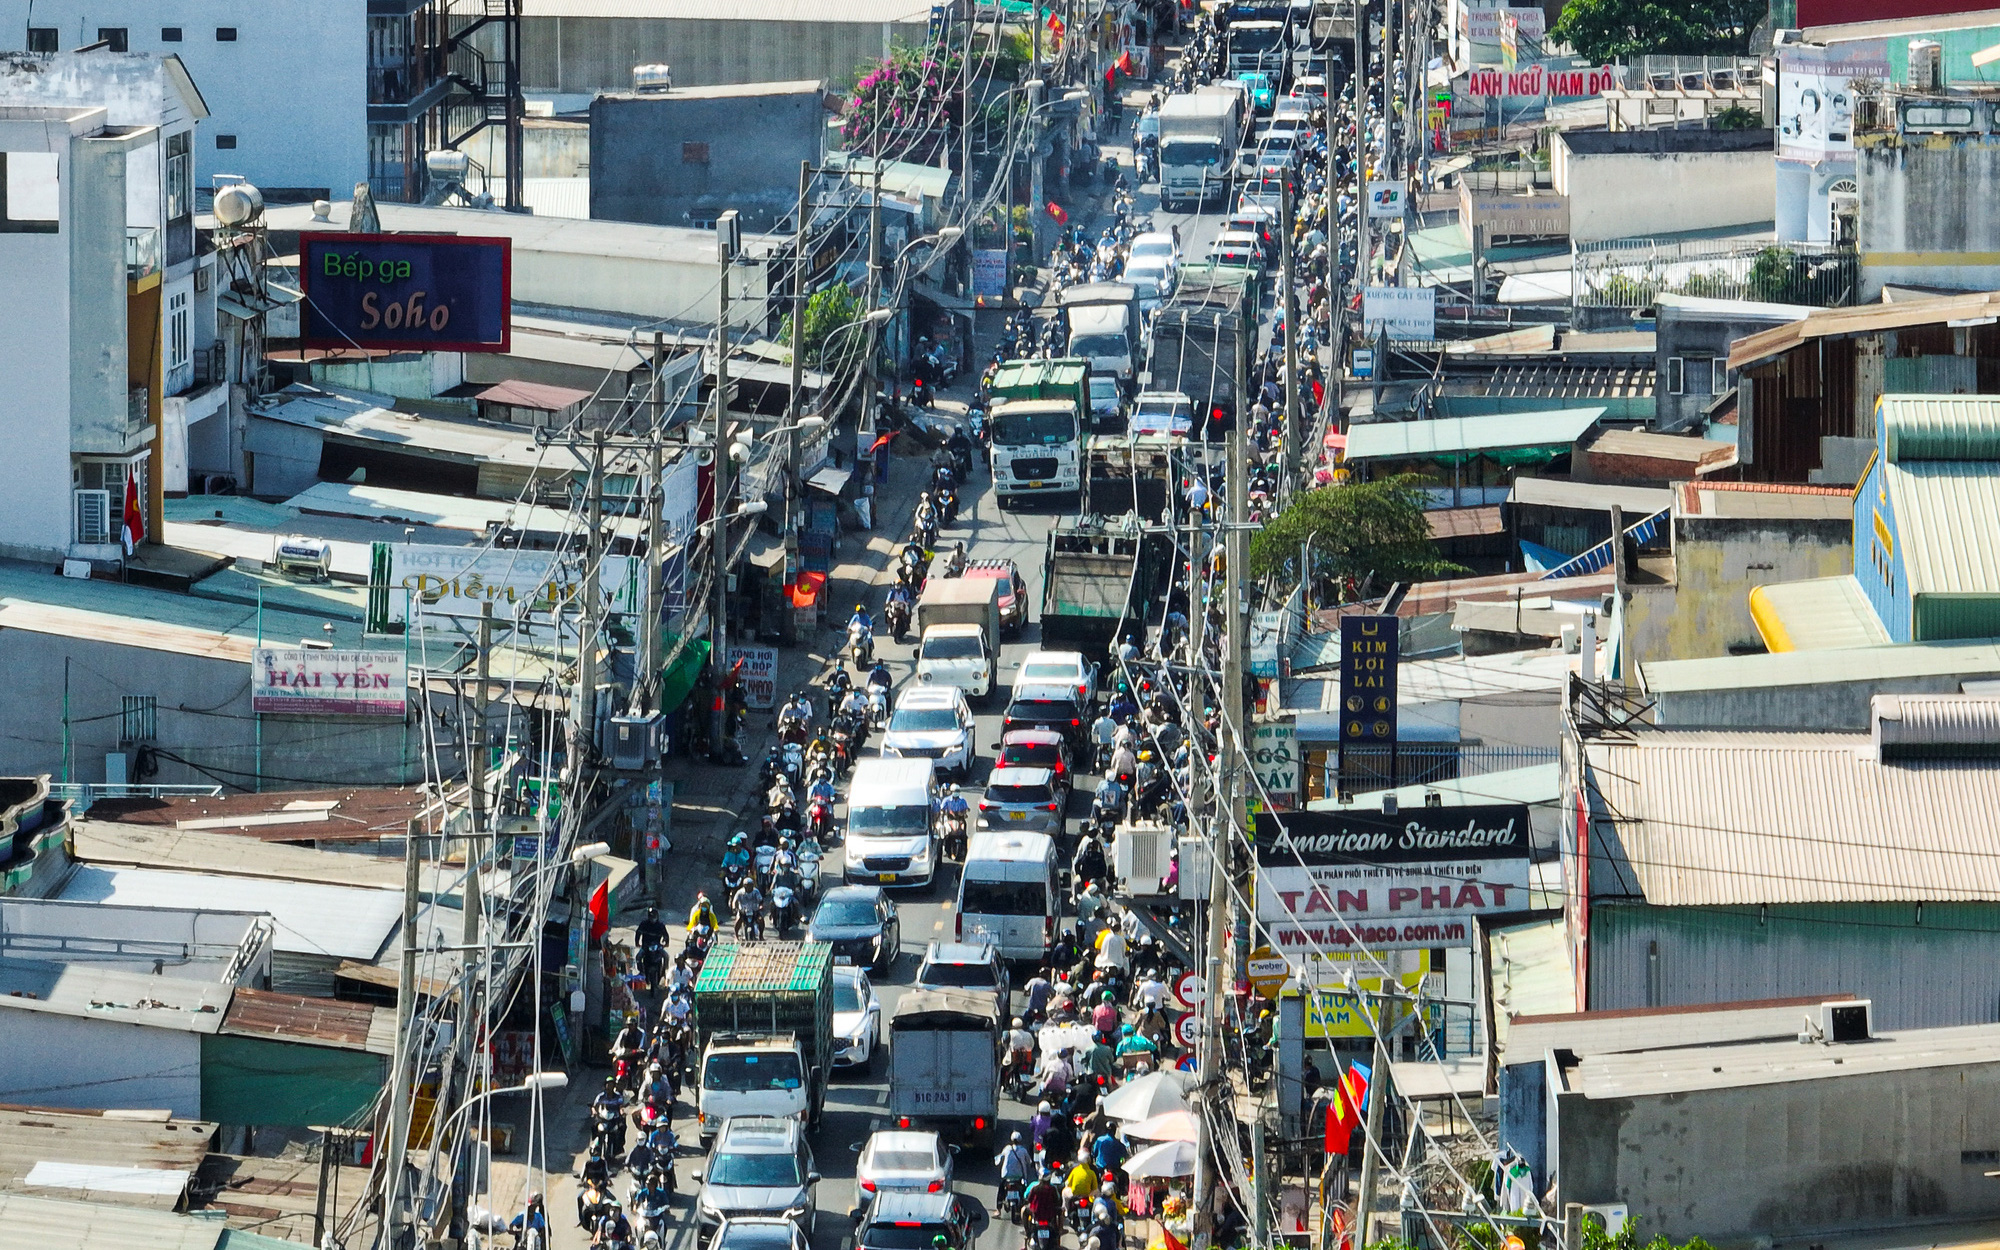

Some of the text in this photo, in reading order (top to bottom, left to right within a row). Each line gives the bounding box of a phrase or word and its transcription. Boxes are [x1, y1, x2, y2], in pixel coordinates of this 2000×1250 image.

[1470, 64, 1612, 96] ANH NGỮ NAM ĐÔ
[324, 251, 411, 283] Bếp ga
[360, 292, 449, 331] Soho
[1352, 641, 1387, 653] KIM
[268, 663, 391, 690] HẢI YẾN
[1354, 656, 1385, 673] LỢI
[1256, 741, 1291, 765] GỖ
[1269, 818, 1517, 855] American Standard
[1434, 863, 1455, 876] THIẾT
[1278, 878, 1515, 914] TÂN PHÁT
[1278, 922, 1466, 948] www.taphaco.com.vn
[1257, 962, 1283, 970] weber
[1310, 1011, 1350, 1025] NAM
